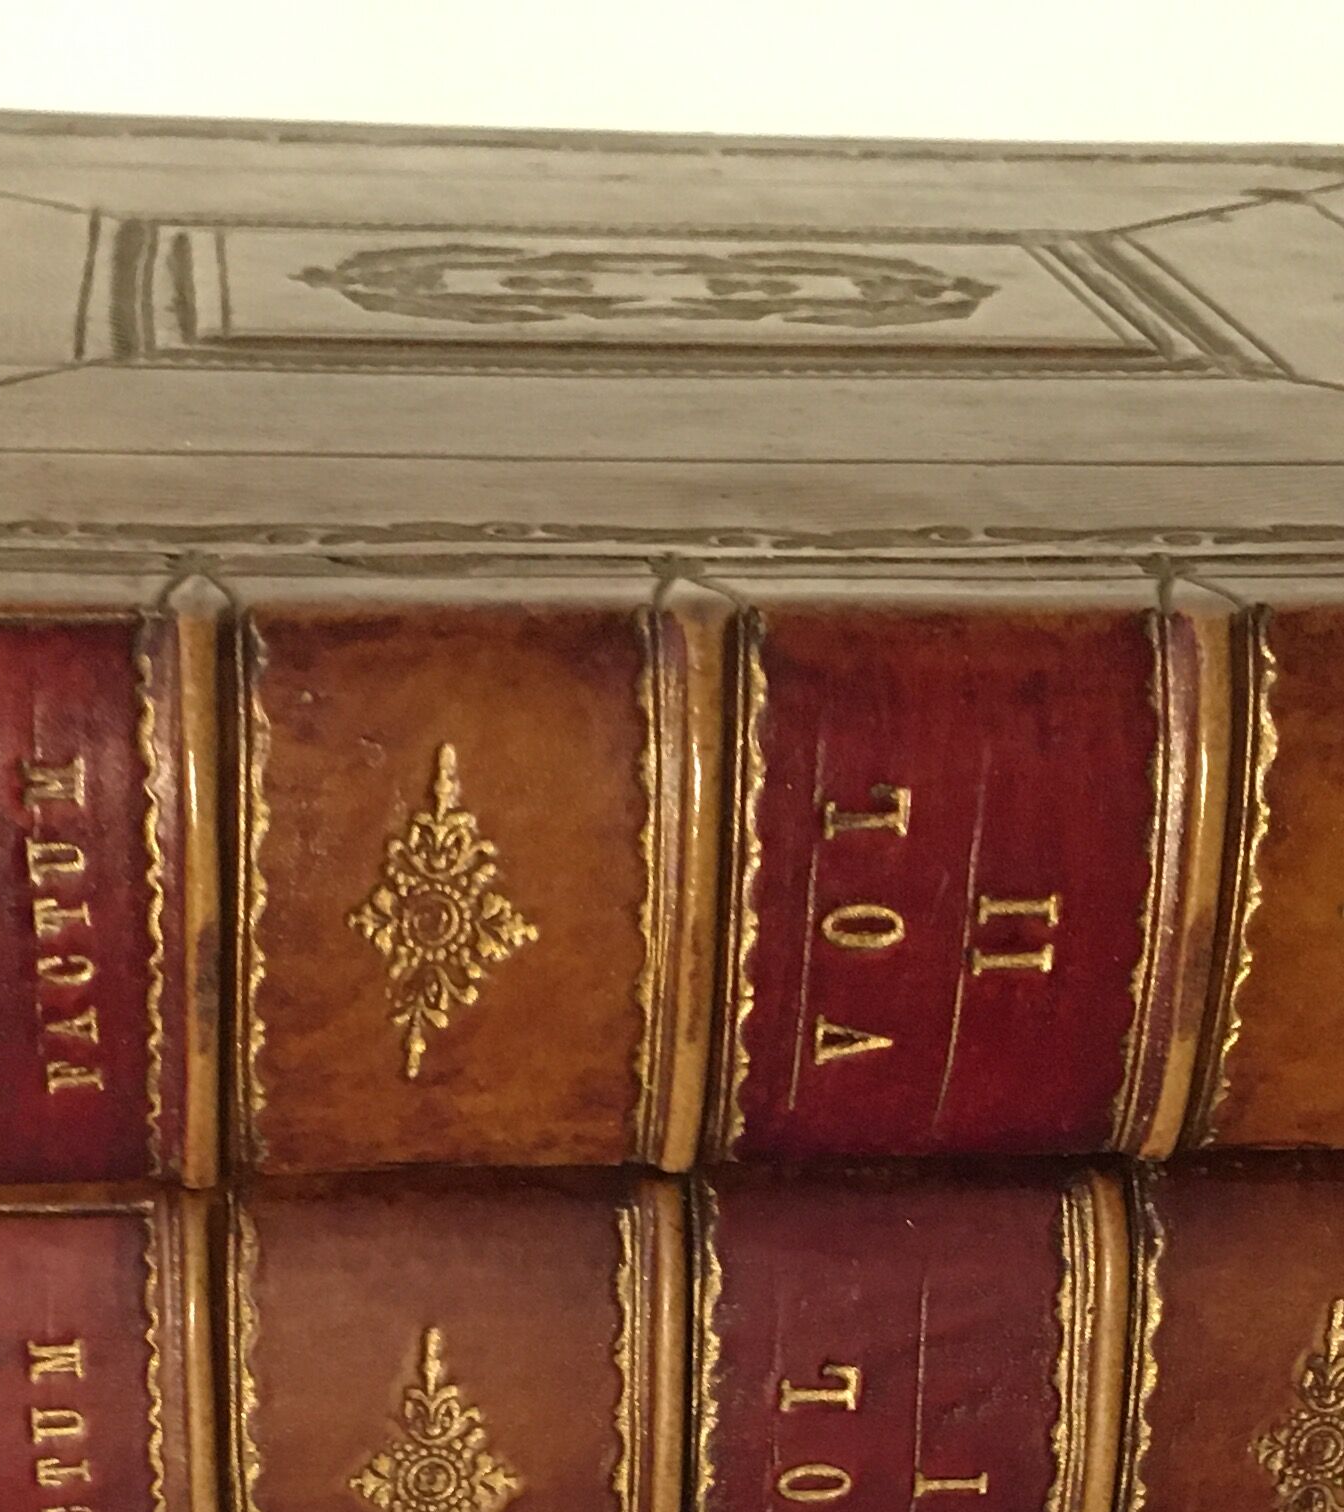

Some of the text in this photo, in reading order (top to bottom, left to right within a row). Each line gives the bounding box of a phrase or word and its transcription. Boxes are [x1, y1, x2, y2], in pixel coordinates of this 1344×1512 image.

[23, 756, 104, 1094] FACTUM
[814, 784, 911, 1065] VOL
[972, 894, 1059, 975] II
[914, 1472, 988, 1497] I
